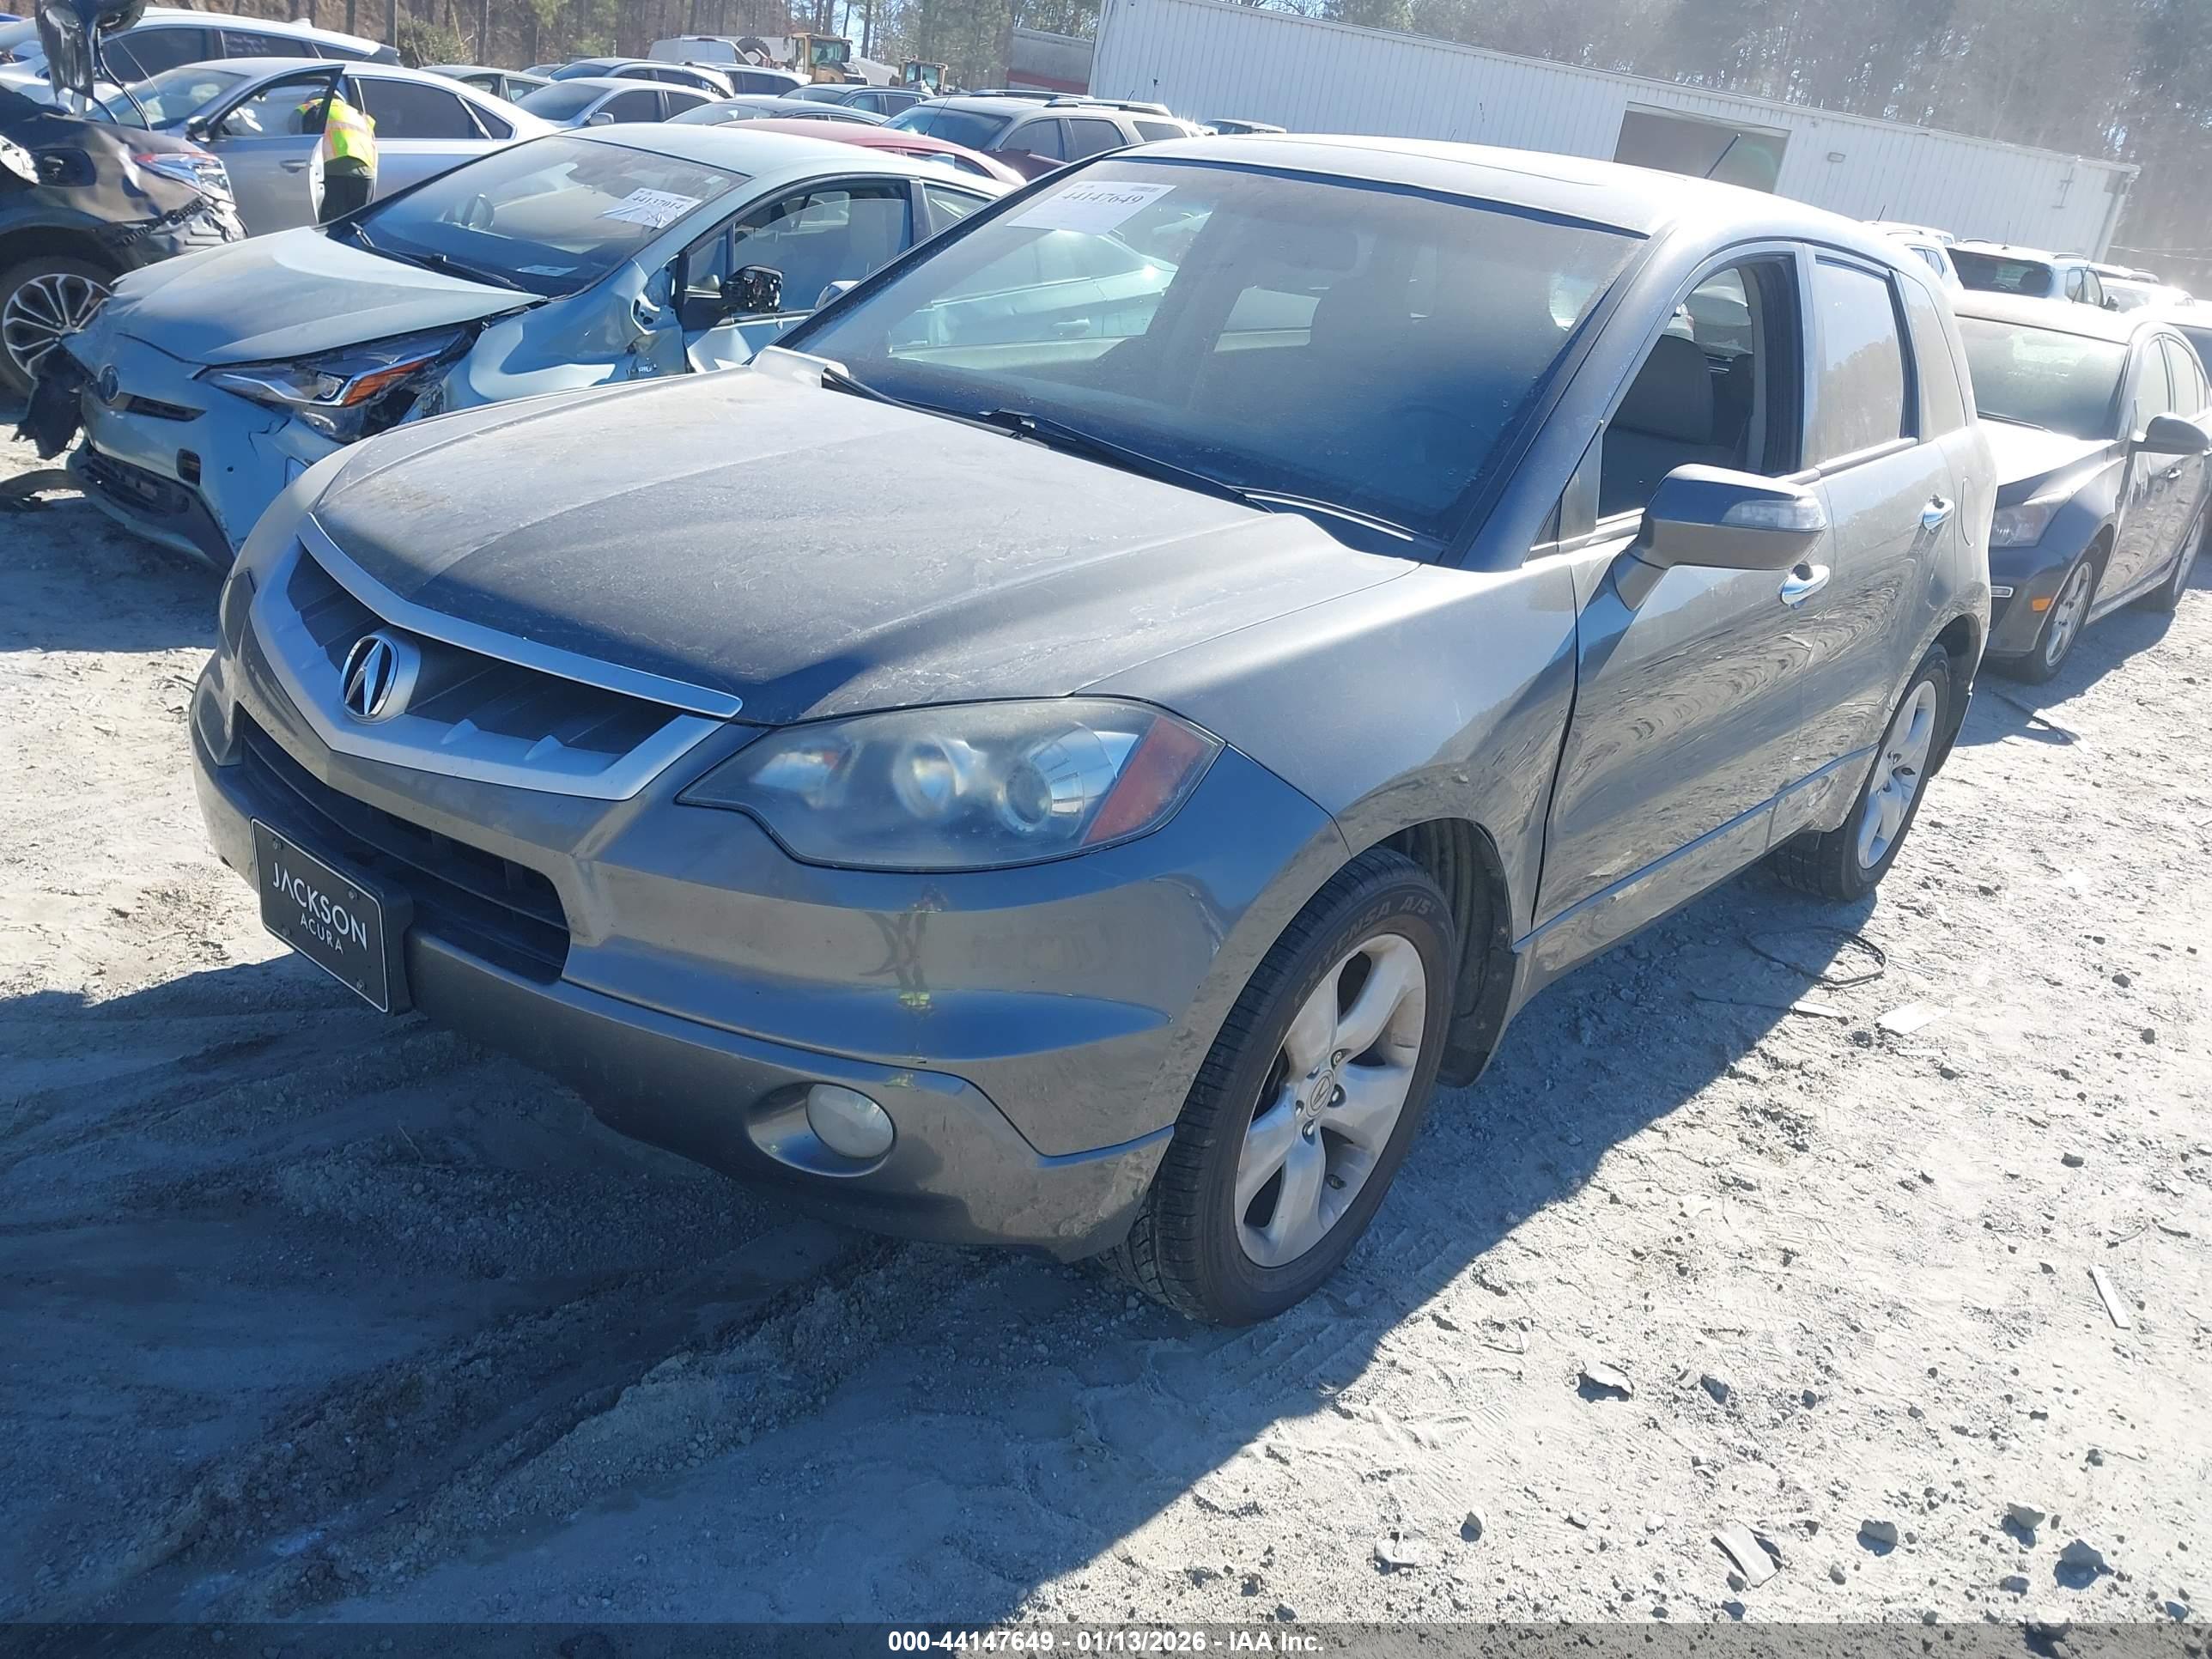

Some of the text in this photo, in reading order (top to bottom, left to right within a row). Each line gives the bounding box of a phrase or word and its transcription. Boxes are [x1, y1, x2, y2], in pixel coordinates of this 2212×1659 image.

[1062, 191, 1144, 204] 44147649
[272, 861, 368, 952] JACKSON
[301, 913, 343, 955] ACURA
